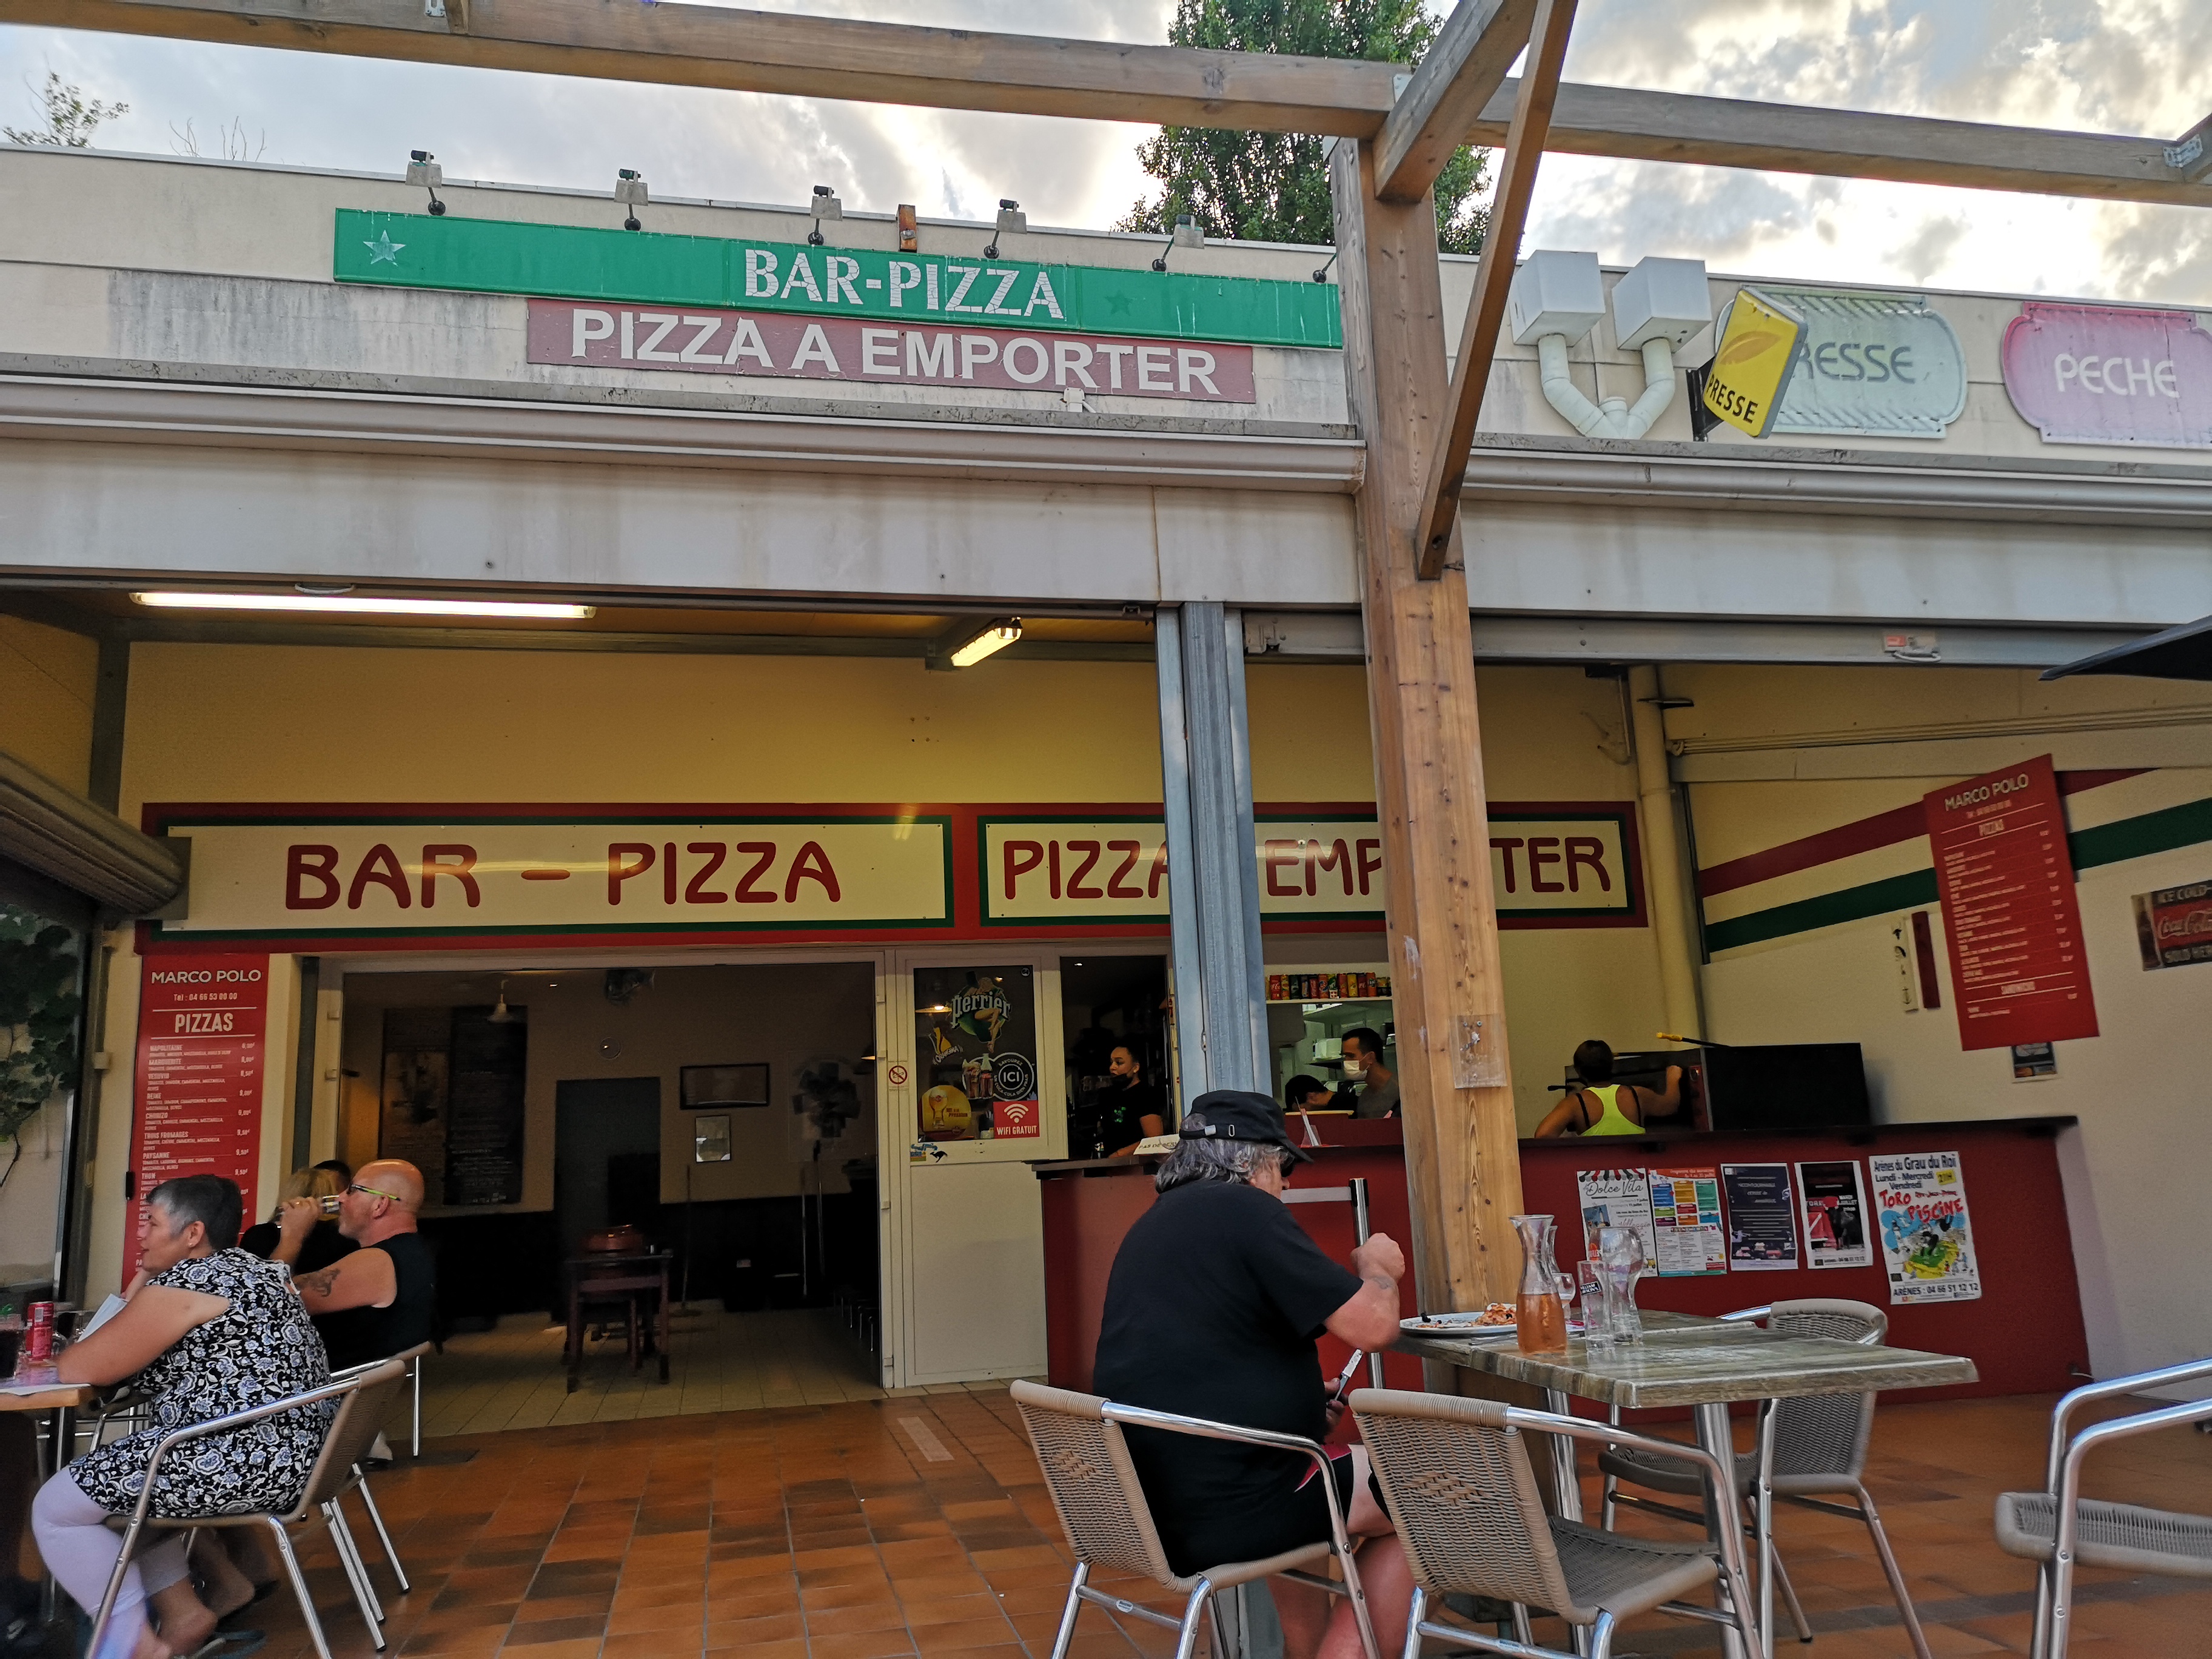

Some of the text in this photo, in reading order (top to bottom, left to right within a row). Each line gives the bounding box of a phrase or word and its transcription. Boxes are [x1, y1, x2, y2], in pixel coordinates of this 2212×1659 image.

[745, 248, 1065, 320] BAR-PIZZA
[571, 308, 1221, 395] PIZZA A EMPORTER
[1797, 342, 1915, 384] RESSE
[2055, 353, 2180, 398] PECHE
[1706, 373, 1758, 424] PRESSE
[1944, 786, 1990, 811] MARCO
[1992, 773, 2029, 796] POLO
[285, 843, 481, 911] BAR
[608, 840, 842, 907] PIZZA
[152, 970, 261, 984] MARCO POLO
[175, 1012, 233, 1033] PIZZAS
[1003, 1071, 1020, 1082] ICI
[996, 1125, 1037, 1135] WIFI GRATUIT
[1904, 1156, 1926, 1170] Grau
[1928, 1155, 1940, 1168] du
[1941, 1153, 1957, 1168] Roi
[1586, 1177, 1644, 1196] Dolce Vita
[1875, 1173, 1896, 1182] Lundi
[1902, 1171, 1934, 1181] Mercredi
[1889, 1180, 1922, 1190] Vendredi
[1959, 1283, 1967, 1292] 12
[1968, 1282, 1979, 1291] 12
